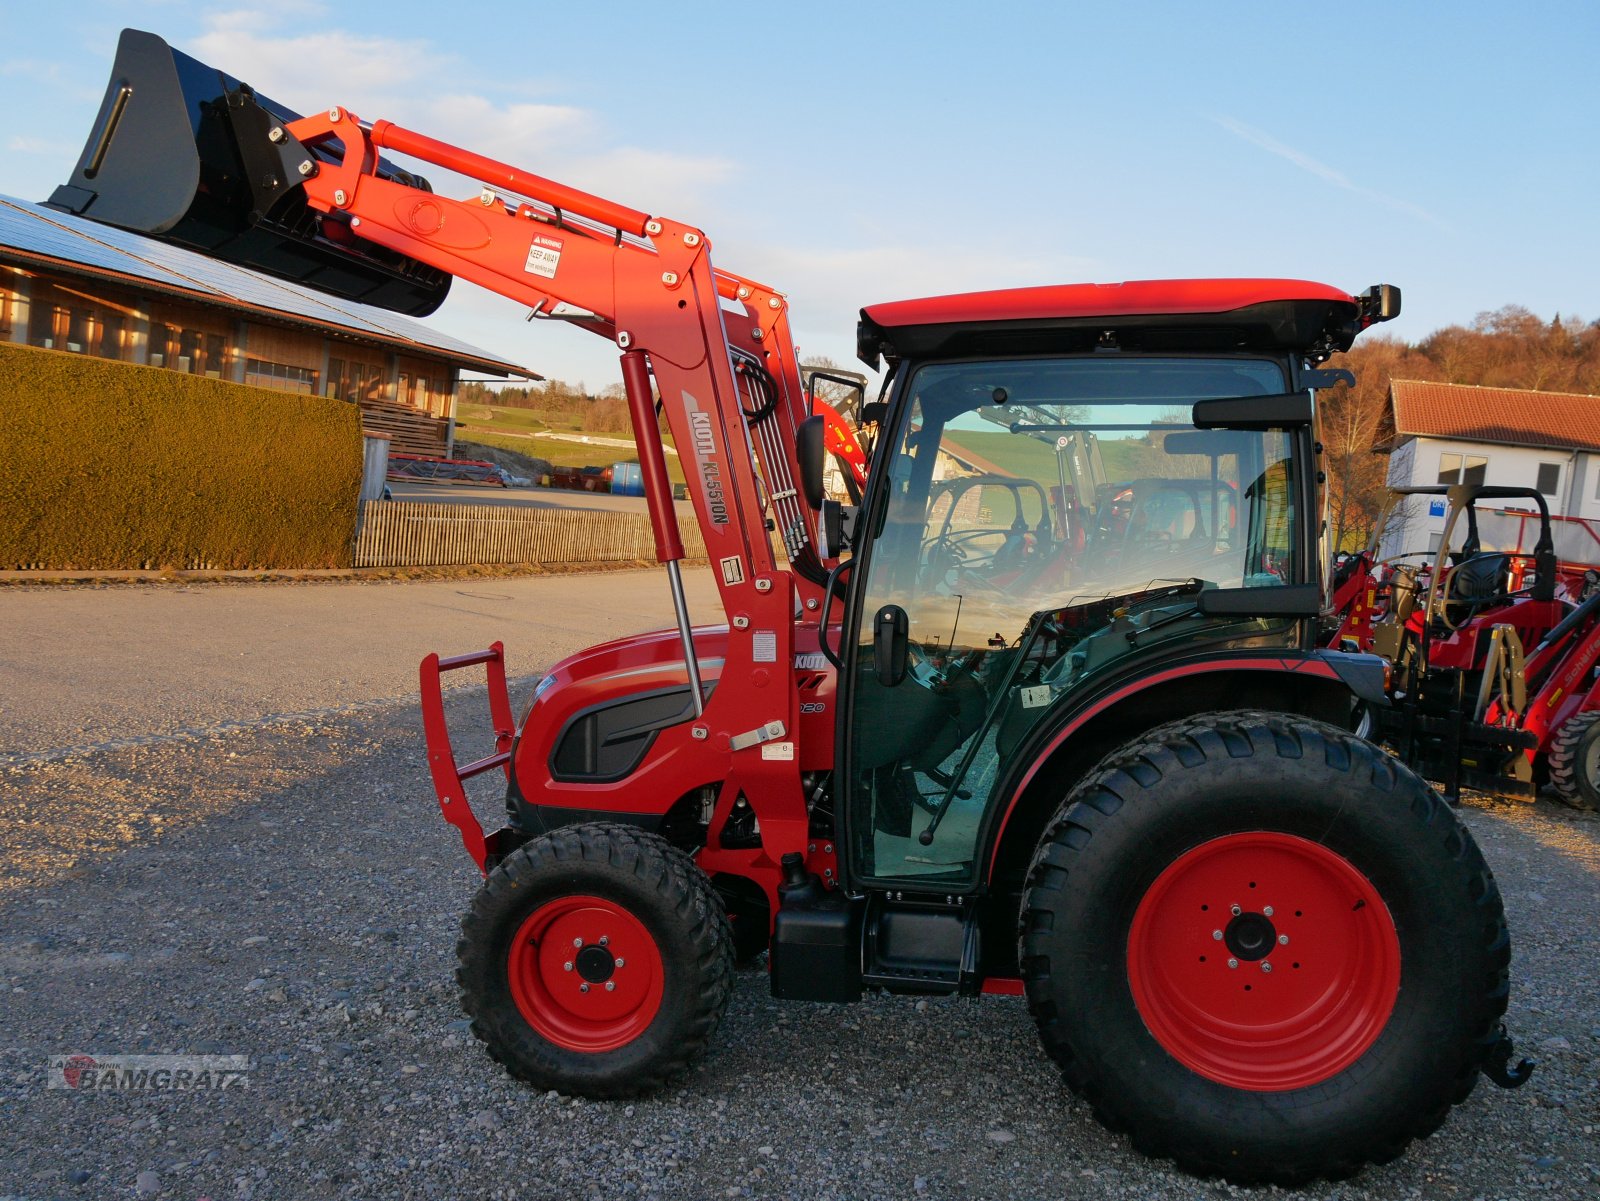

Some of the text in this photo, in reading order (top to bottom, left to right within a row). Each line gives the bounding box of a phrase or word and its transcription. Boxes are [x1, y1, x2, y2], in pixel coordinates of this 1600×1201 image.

[530, 249, 559, 264] KEEP AWAY
[690, 411, 729, 525] KIOTI KL5510N
[794, 655, 826, 669] KIOTI
